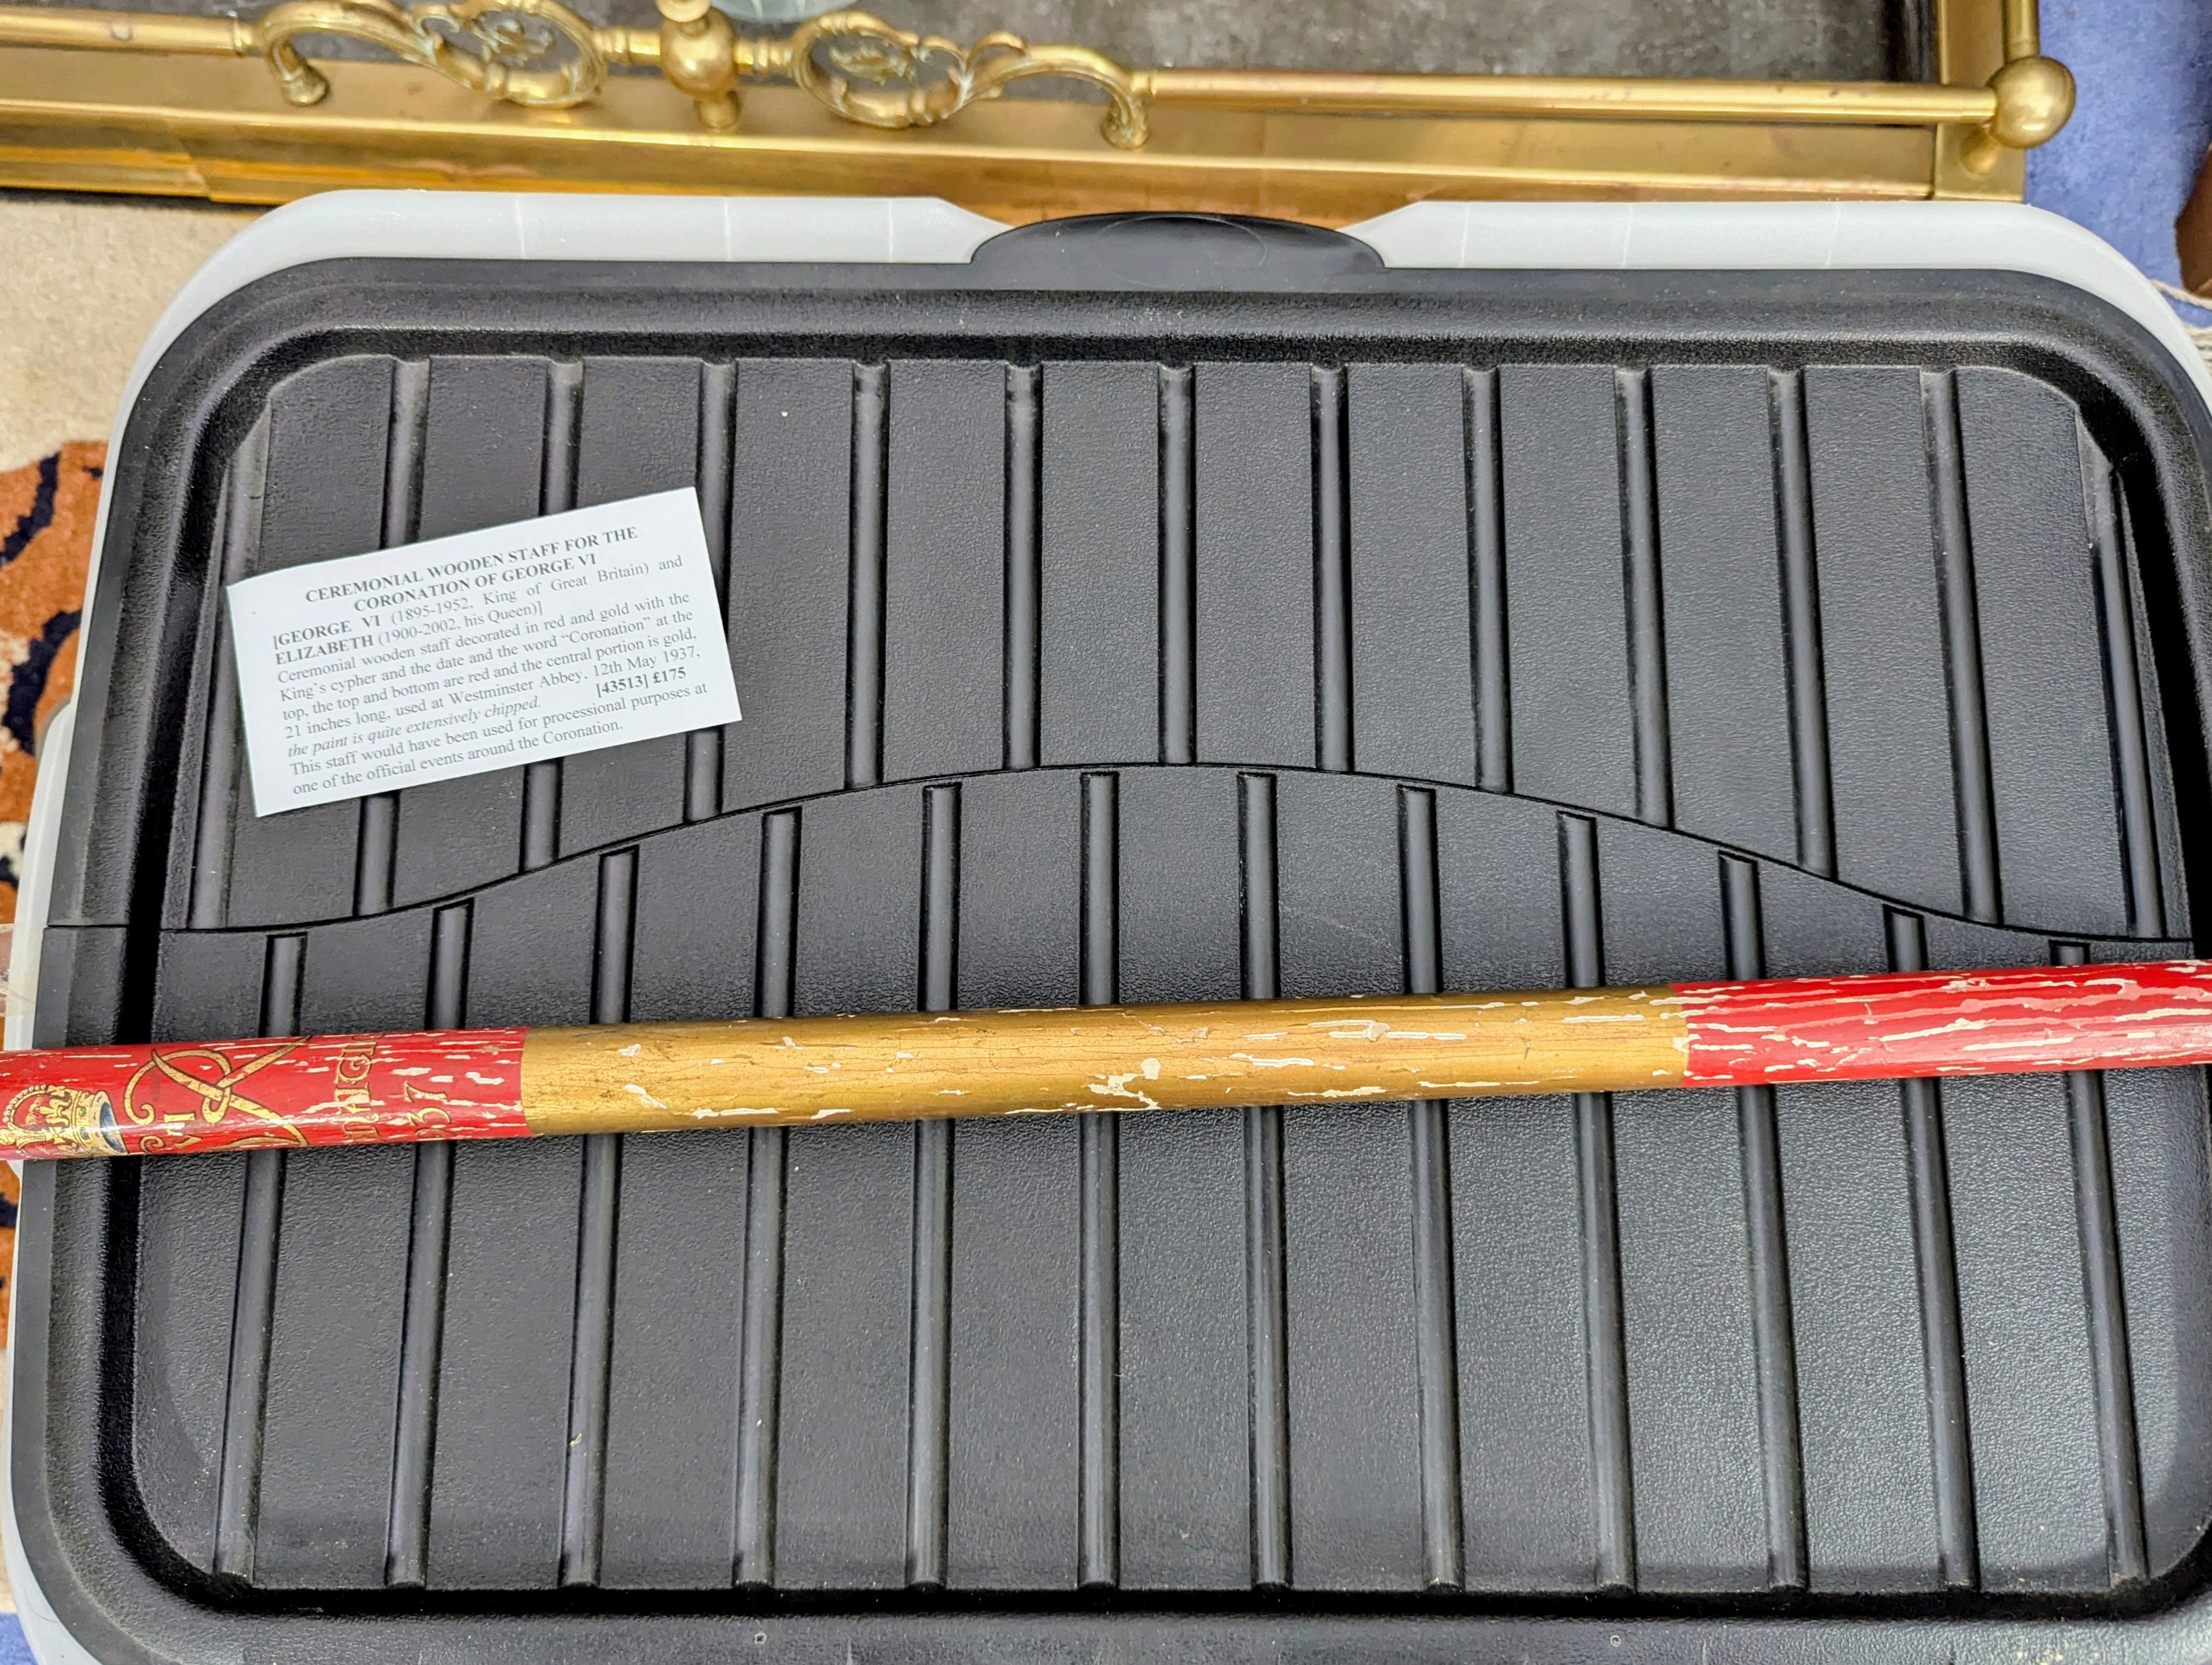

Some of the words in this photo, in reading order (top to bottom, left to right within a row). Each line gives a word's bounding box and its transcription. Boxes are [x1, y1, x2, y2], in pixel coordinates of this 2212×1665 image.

[272, 620, 353, 651] [GEORGE
[361, 615, 381, 628] VI
[390, 596, 474, 626] (1895-1952,
[482, 590, 518, 606] King
[526, 581, 543, 596] of
[550, 575, 589, 591] Great
[597, 562, 649, 583] Britain)
[659, 554, 684, 571] and
[305, 570, 424, 603] CEREMONIAL
[426, 553, 505, 579] WOODEN
[507, 541, 560, 564] STAFF
[564, 534, 601, 552] FOR
[602, 526, 639, 544] THE
[353, 578, 471, 612] CORONATION
[474, 572, 498, 588] OF
[501, 557, 575, 583] GEORGE
[577, 553, 597, 567] VI
[274, 634, 374, 666] ELIZABETH
[378, 617, 461, 646] (1900-2002,
[463, 613, 485, 628] his
[487, 600, 543, 624] Queen)]
[277, 656, 357, 684] Ceremonial
[361, 648, 416, 666] wooden
[420, 637, 452, 656] staff
[455, 623, 522, 648] decorated
[525, 621, 540, 635] in
[543, 614, 566, 631] red
[570, 608, 596, 625] and
[599, 602, 630, 623] gold
[634, 596, 665, 612] with
[668, 592, 690, 606] the
[282, 708, 310, 722] top,
[311, 700, 334, 715] the
[336, 697, 360, 711] top
[363, 687, 389, 704] and
[390, 681, 441, 699] bottom
[443, 676, 465, 688] are
[467, 667, 491, 683] red
[493, 661, 519, 678] and
[521, 659, 543, 673] the
[545, 646, 593, 667] central
[595, 640, 645, 662] portion
[647, 635, 660, 648] is
[663, 627, 698, 648] gold,
[330, 674, 378, 694] cypher
[381, 665, 407, 682] and
[410, 662, 432, 675] the
[436, 657, 465, 671] date
[469, 647, 494, 664] and
[497, 645, 519, 658] the
[522, 635, 559, 653] word
[656, 615, 669, 627] at
[672, 610, 693, 624] the
[285, 724, 301, 740] 21
[307, 717, 352, 735] inches
[355, 710, 391, 725] long,
[394, 698, 428, 717] used
[431, 698, 445, 710] at
[448, 681, 535, 705] Westminster
[539, 671, 589, 688] Abbey,
[593, 660, 623, 677] 12th
[626, 656, 657, 671] May
[663, 645, 701, 664] 1937,
[288, 743, 309, 758] the
[312, 736, 348, 757] paint
[352, 732, 364, 745] is
[367, 725, 402, 745] quite
[406, 708, 481, 734] extensively
[484, 695, 541, 719] chipped.
[595, 673, 649, 699] [43513]
[652, 666, 687, 685] £175
[289, 759, 322, 776] This
[325, 750, 359, 769] staff
[361, 741, 405, 761] would
[407, 737, 441, 753] have
[444, 730, 479, 745] been
[482, 719, 514, 738] used
[518, 716, 539, 731] for
[541, 696, 627, 729] processional
[630, 687, 691, 711] purposes
[694, 683, 708, 695] at
[293, 782, 319, 795] one
[322, 773, 339, 789] of
[340, 771, 363, 786] the
[366, 758, 417, 781] official
[419, 753, 465, 770] events
[467, 738, 516, 761] around
[518, 736, 540, 750] the
[542, 721, 623, 745] Coronation.
